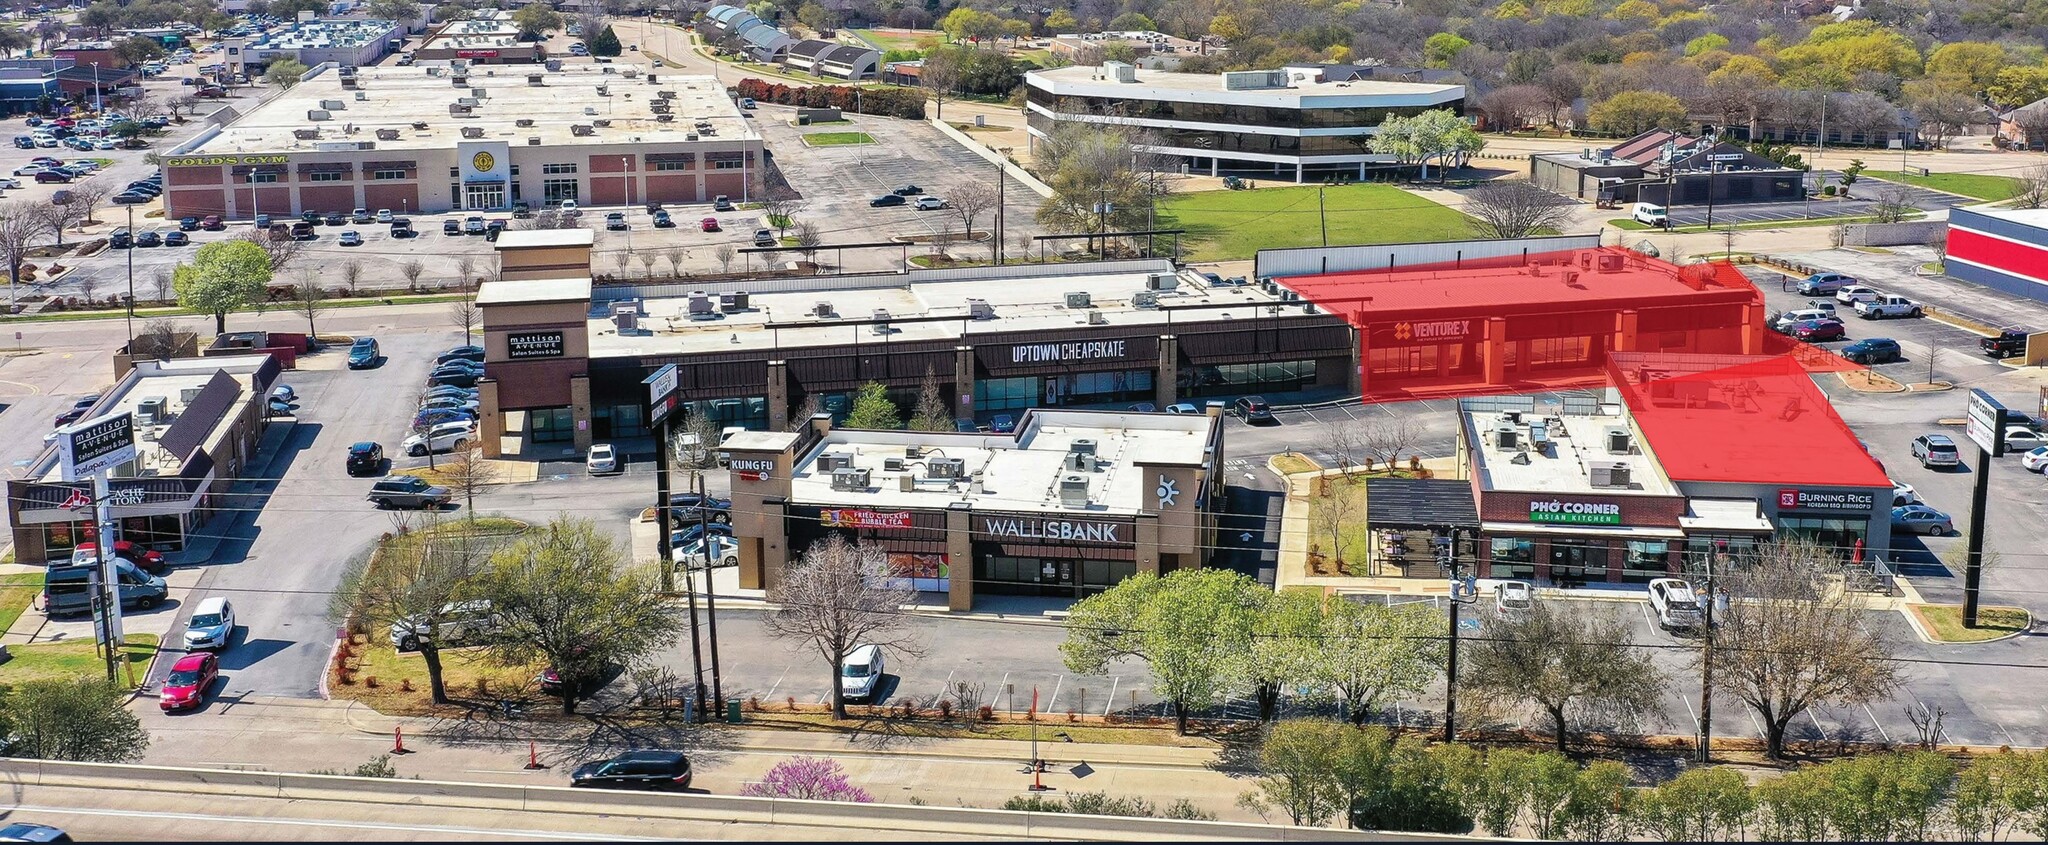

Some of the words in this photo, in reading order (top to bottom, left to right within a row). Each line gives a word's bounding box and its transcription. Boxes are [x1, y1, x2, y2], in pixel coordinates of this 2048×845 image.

[167, 156, 238, 166] GOLD'S
[243, 155, 288, 165] GYM
[1413, 321, 1460, 337] VENTURE
[1461, 320, 1469, 335] X
[510, 334, 561, 343] mattison
[1012, 344, 1059, 362] UPTOWN
[1061, 341, 1125, 360] CHEAPSKATE
[1979, 402, 1995, 422] CORNER
[76, 418, 128, 443] mattison
[78, 451, 95, 462] Salon
[95, 445, 112, 455] Suites
[74, 459, 108, 476] Palapas
[731, 460, 760, 470] KUNG
[760, 460, 773, 470] FU
[1799, 492, 1845, 503] BURNING
[1847, 494, 1872, 503] RICE
[1562, 502, 1620, 515] CORNER
[861, 518, 887, 526] BUBBLE
[986, 519, 1117, 542] WALLISBANK
